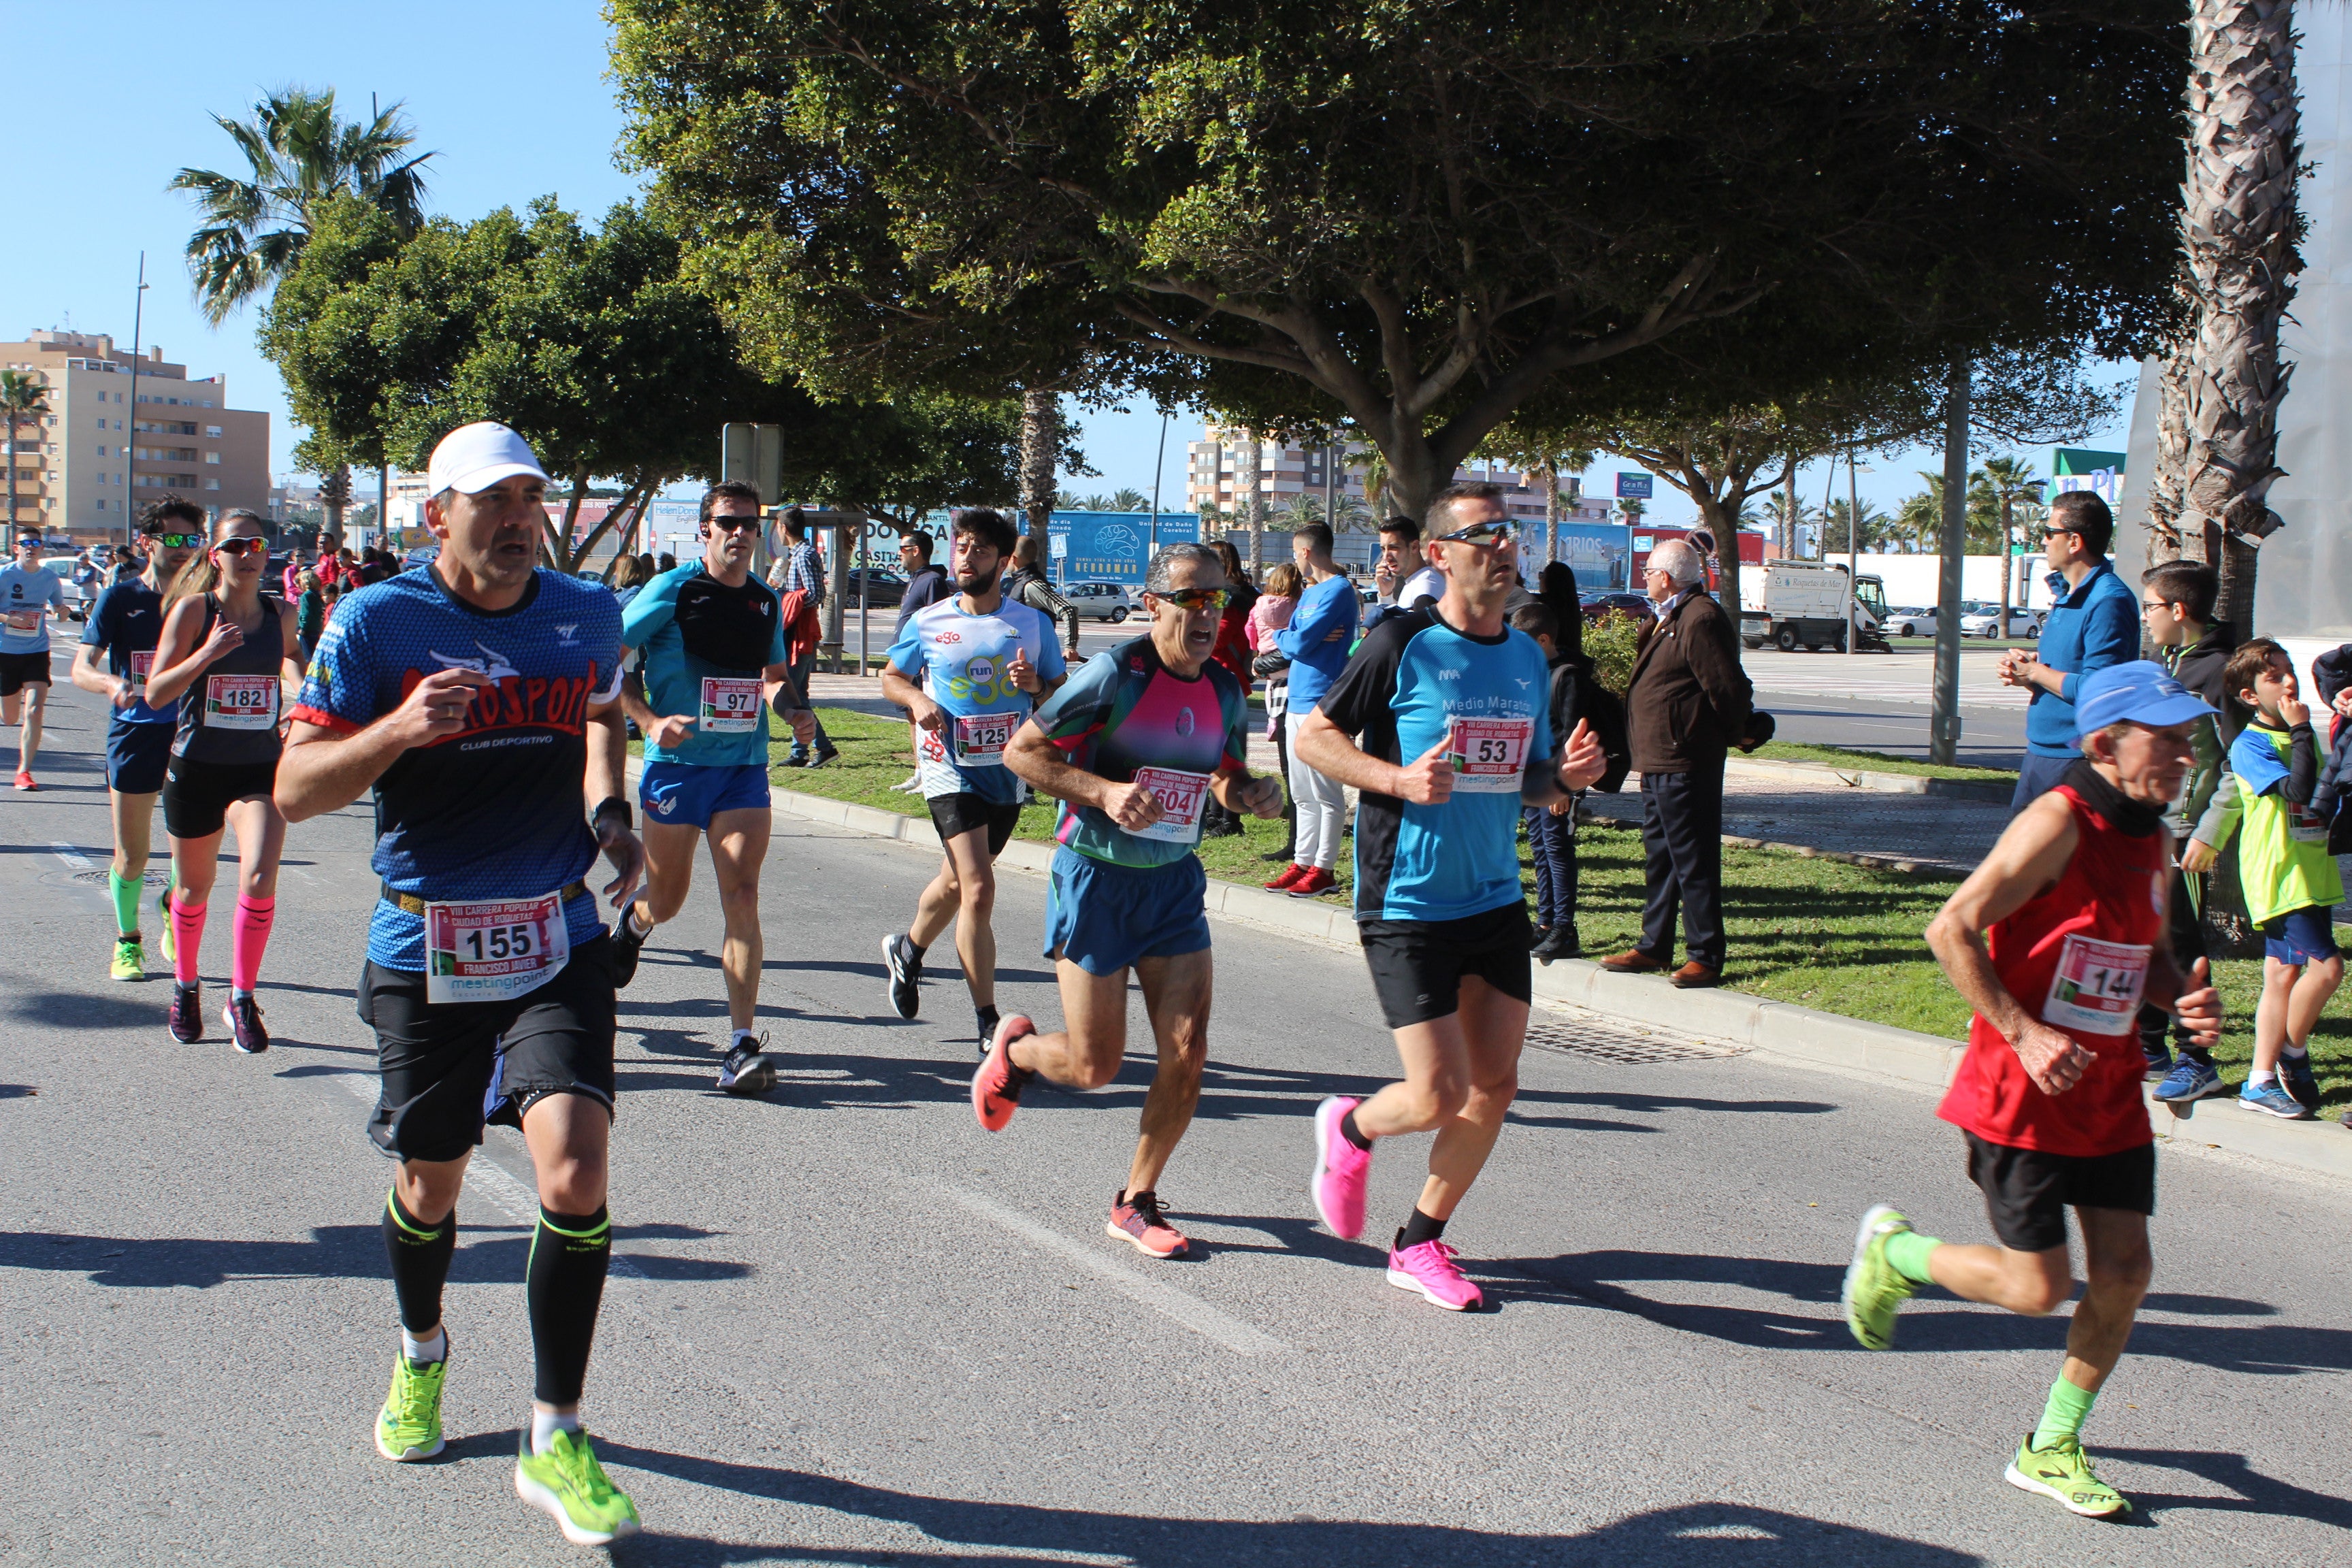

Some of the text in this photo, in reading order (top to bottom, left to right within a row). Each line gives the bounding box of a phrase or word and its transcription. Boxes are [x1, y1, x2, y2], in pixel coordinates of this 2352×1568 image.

[655, 505, 677, 514] Helen
[676, 516, 698, 524] English
[1075, 562, 1137, 574] NEUROMAR
[1793, 578, 1819, 589] Roquetas
[1828, 579, 1841, 587] Mar
[936, 632, 960, 644] ego
[970, 666, 993, 676] run
[228, 690, 261, 706] 182
[728, 693, 748, 710] 97
[1442, 698, 1484, 712] Medio
[460, 735, 554, 751] CLUB DEPORTIVO
[974, 728, 1005, 745] 125
[1478, 740, 1507, 763] 53
[1149, 778, 1167, 787] CIUDAD
[1161, 773, 1181, 782] CARRERA
[1155, 788, 1191, 813] 604
[450, 902, 539, 916] VIII CARRERA POPULAR
[451, 913, 534, 926] CIUDAD DE ROQUETAS
[467, 925, 532, 960] 155
[464, 959, 538, 975] FRANCISCO JAVIER
[451, 968, 550, 990] meetingpoint
